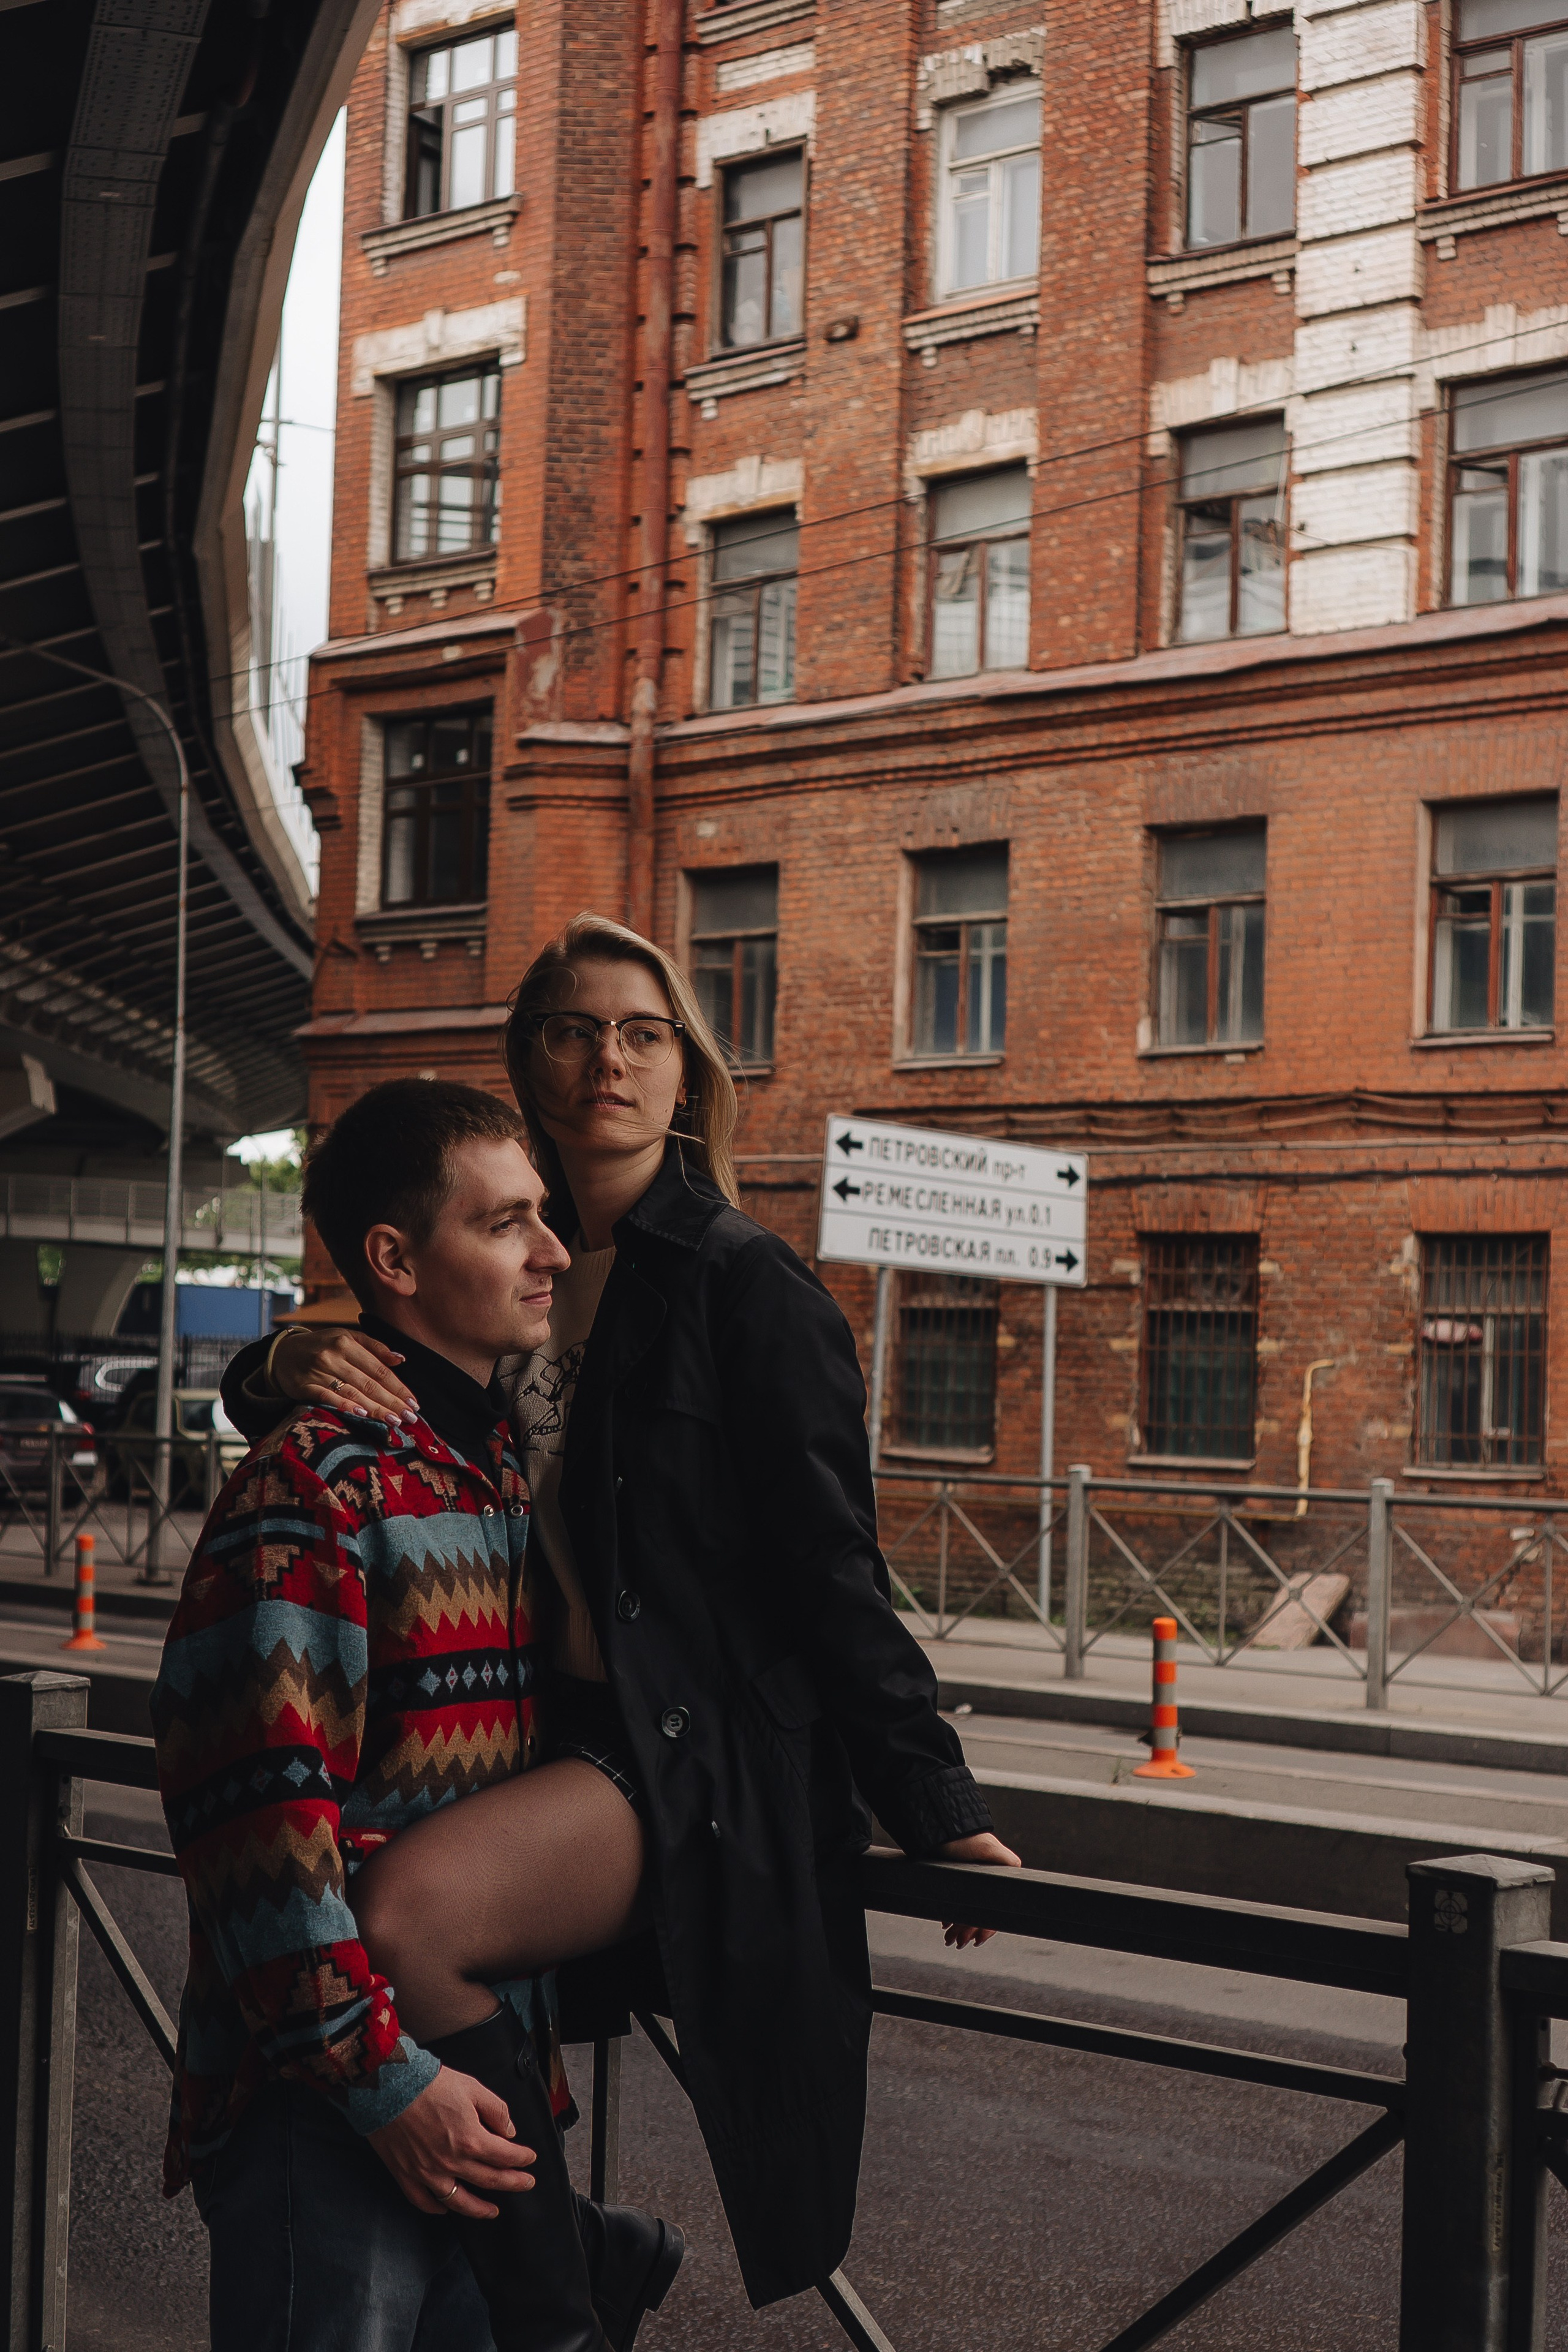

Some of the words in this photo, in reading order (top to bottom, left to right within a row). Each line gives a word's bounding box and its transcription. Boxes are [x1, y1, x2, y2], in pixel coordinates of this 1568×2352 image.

[869, 1137, 987, 1172] ПЕТРОВСКИЙ
[992, 1161, 1026, 1183] пр-т
[863, 1182, 1001, 1219] РЕМЕСЛЕННАЯ
[868, 1227, 991, 1262] ПЕТРОВСКАЯ
